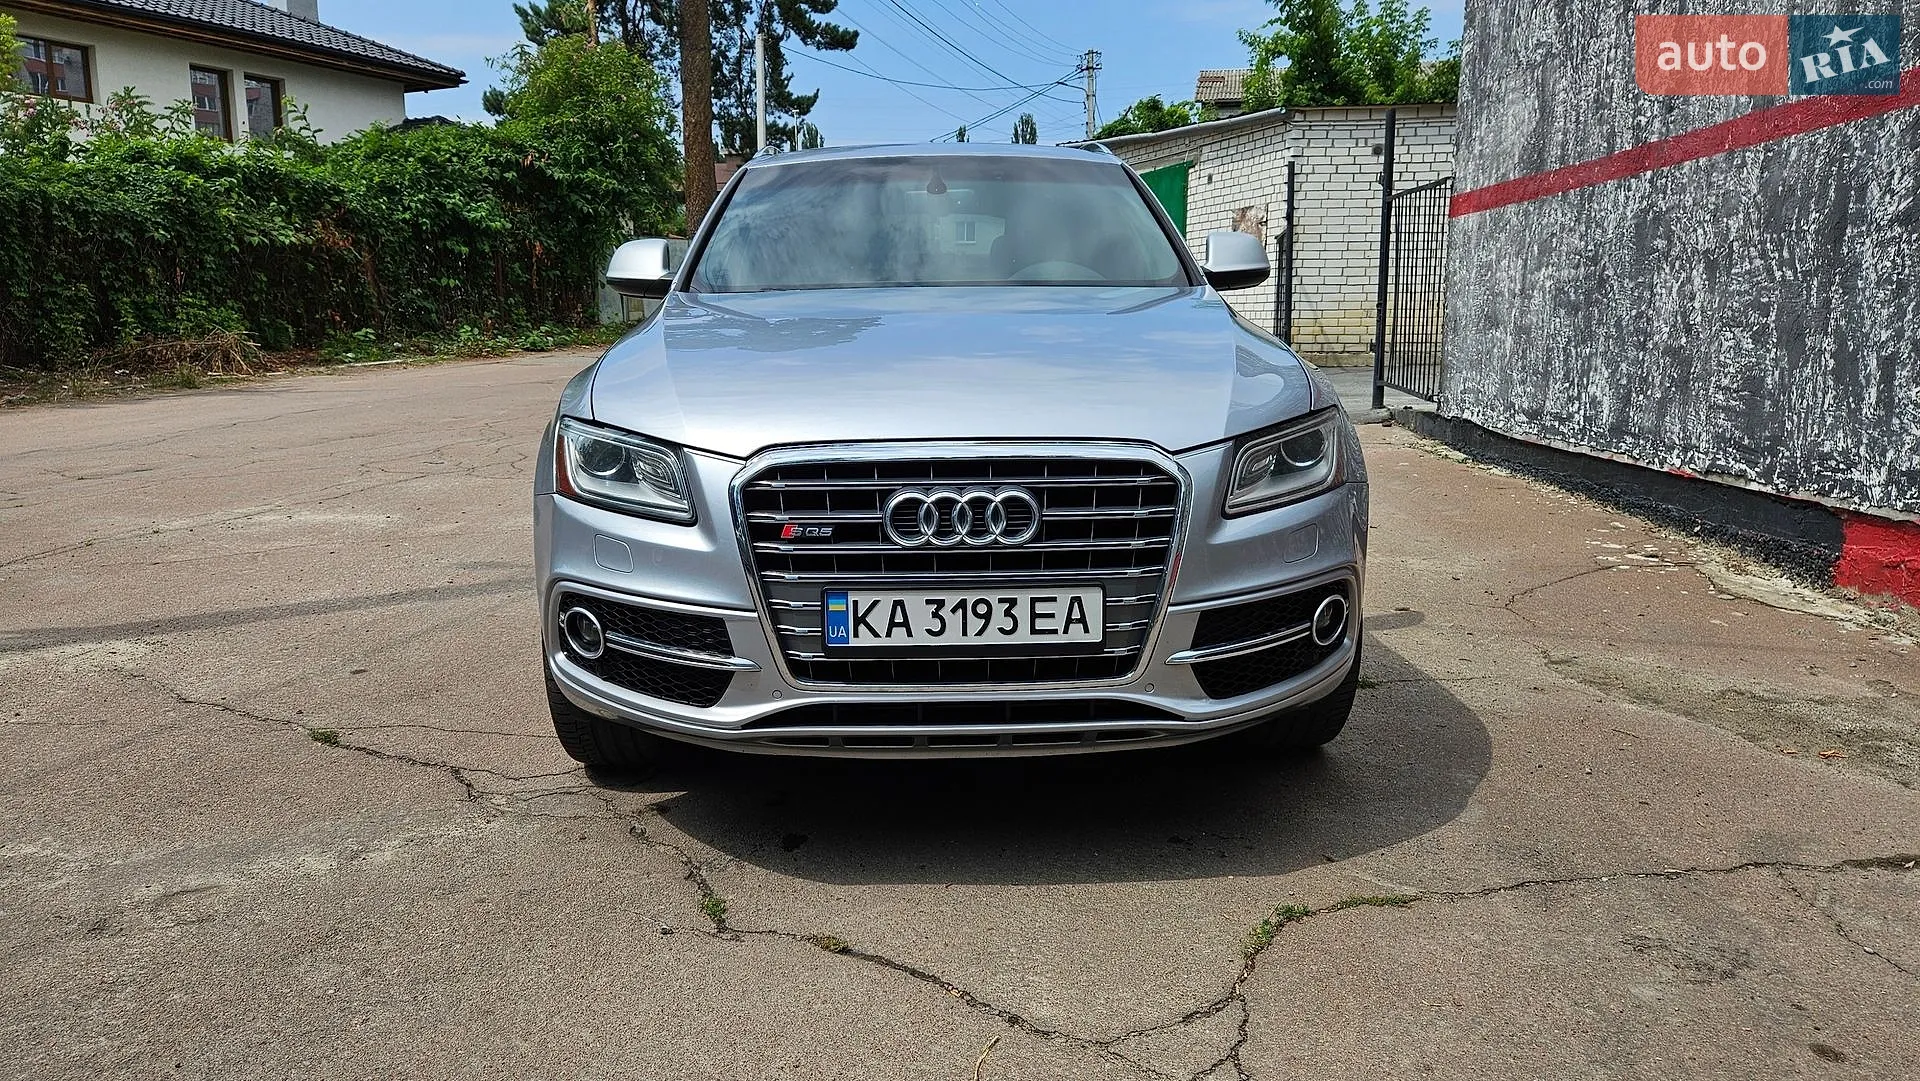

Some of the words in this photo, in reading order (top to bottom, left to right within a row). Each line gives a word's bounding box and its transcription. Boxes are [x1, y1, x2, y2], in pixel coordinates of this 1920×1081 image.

[852, 598, 914, 639] KA
[924, 597, 1019, 637] 3193
[1029, 595, 1090, 635] EA
[829, 625, 847, 638] UA
